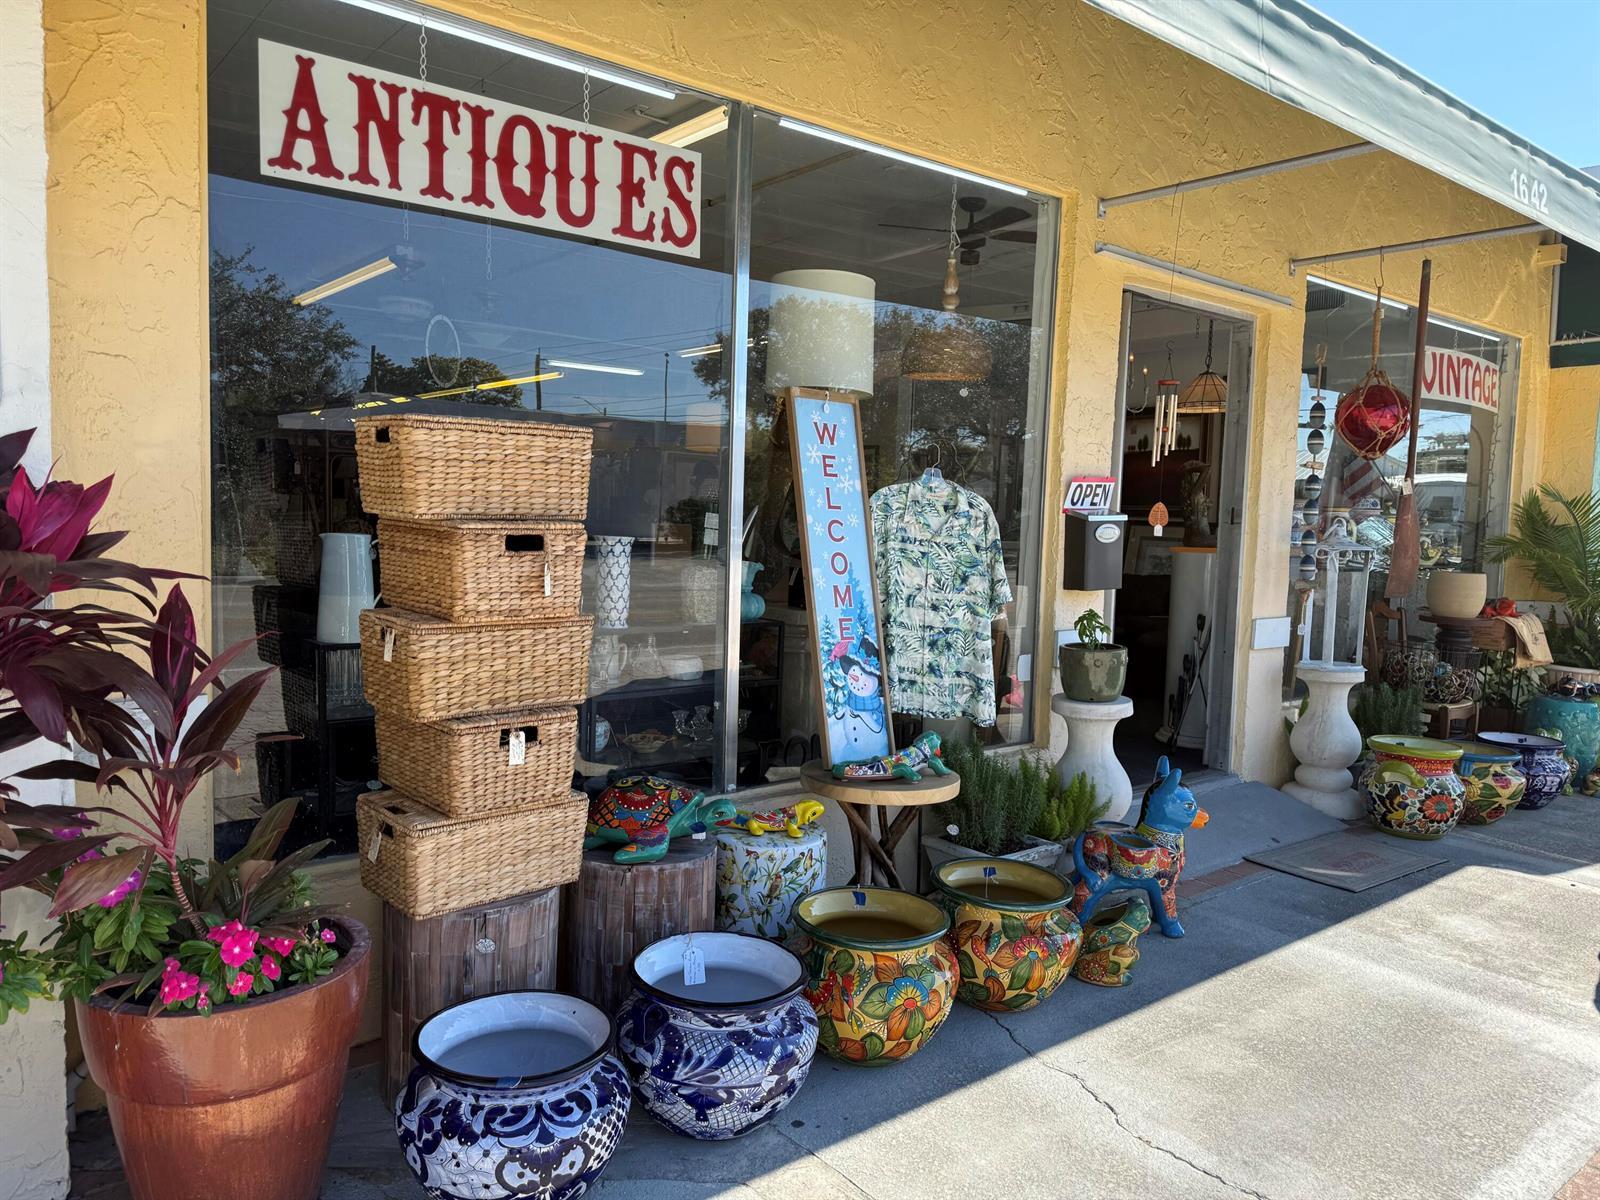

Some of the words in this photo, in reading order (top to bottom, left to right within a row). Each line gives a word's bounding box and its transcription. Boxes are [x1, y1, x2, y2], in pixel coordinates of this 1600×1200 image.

[268, 54, 698, 249] ANTIQUES
[1510, 168, 1549, 215] 1642
[1421, 351, 1498, 409] VINTAGE
[1070, 483, 1111, 507] OPEN
[813, 421, 855, 641] WELCOME
